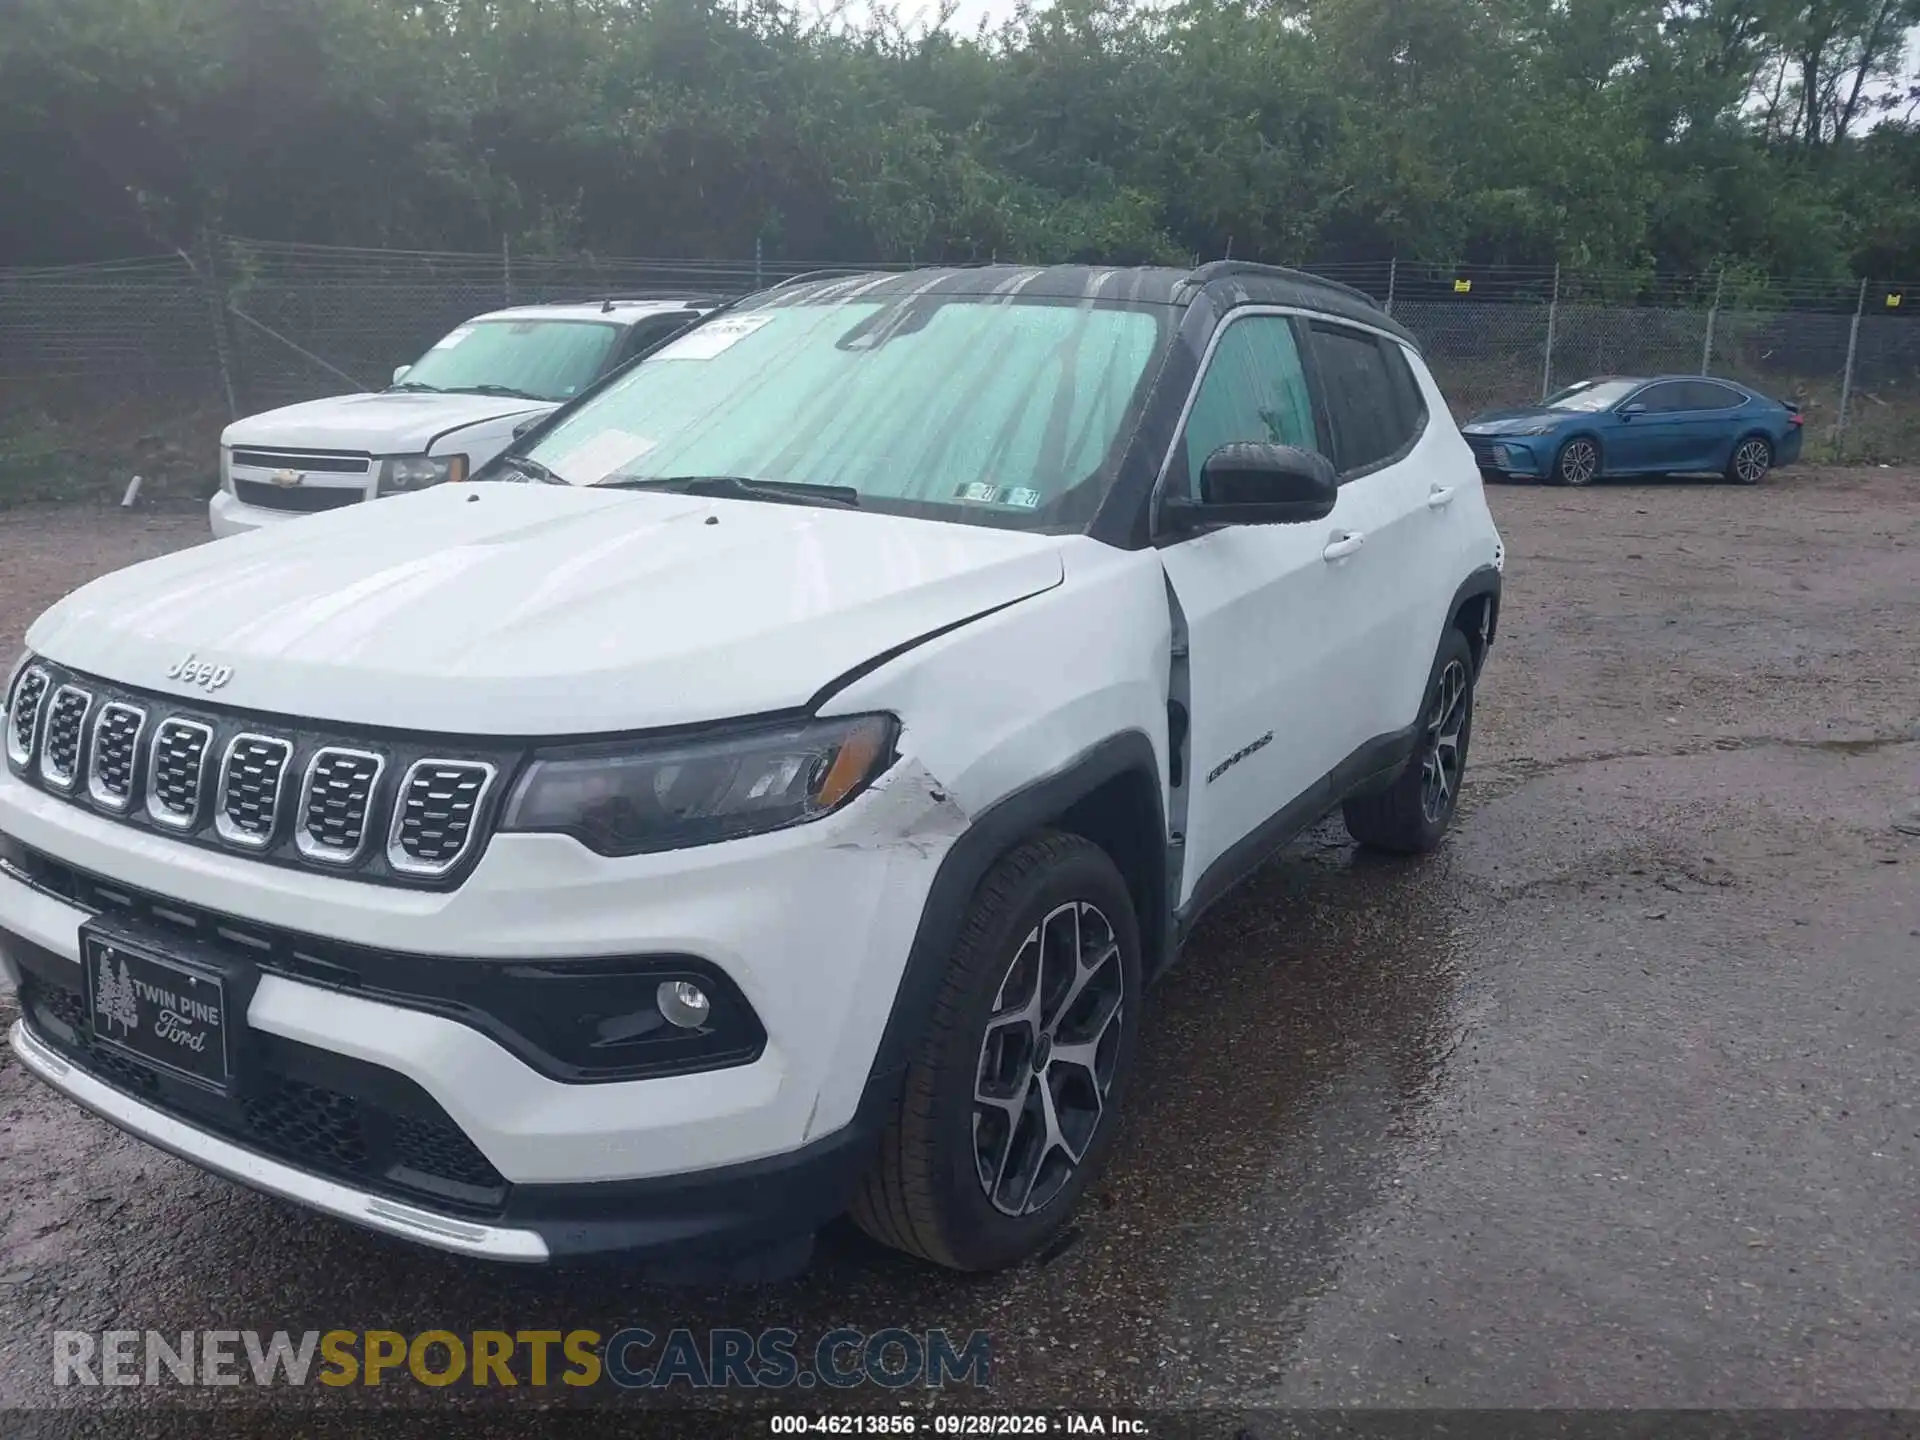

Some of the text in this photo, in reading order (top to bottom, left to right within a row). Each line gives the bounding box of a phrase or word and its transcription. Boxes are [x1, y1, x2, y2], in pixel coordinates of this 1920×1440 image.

[166, 653, 234, 693] Jeep
[133, 979, 220, 1026] TWIN PINE
[155, 1009, 205, 1052] Ford
